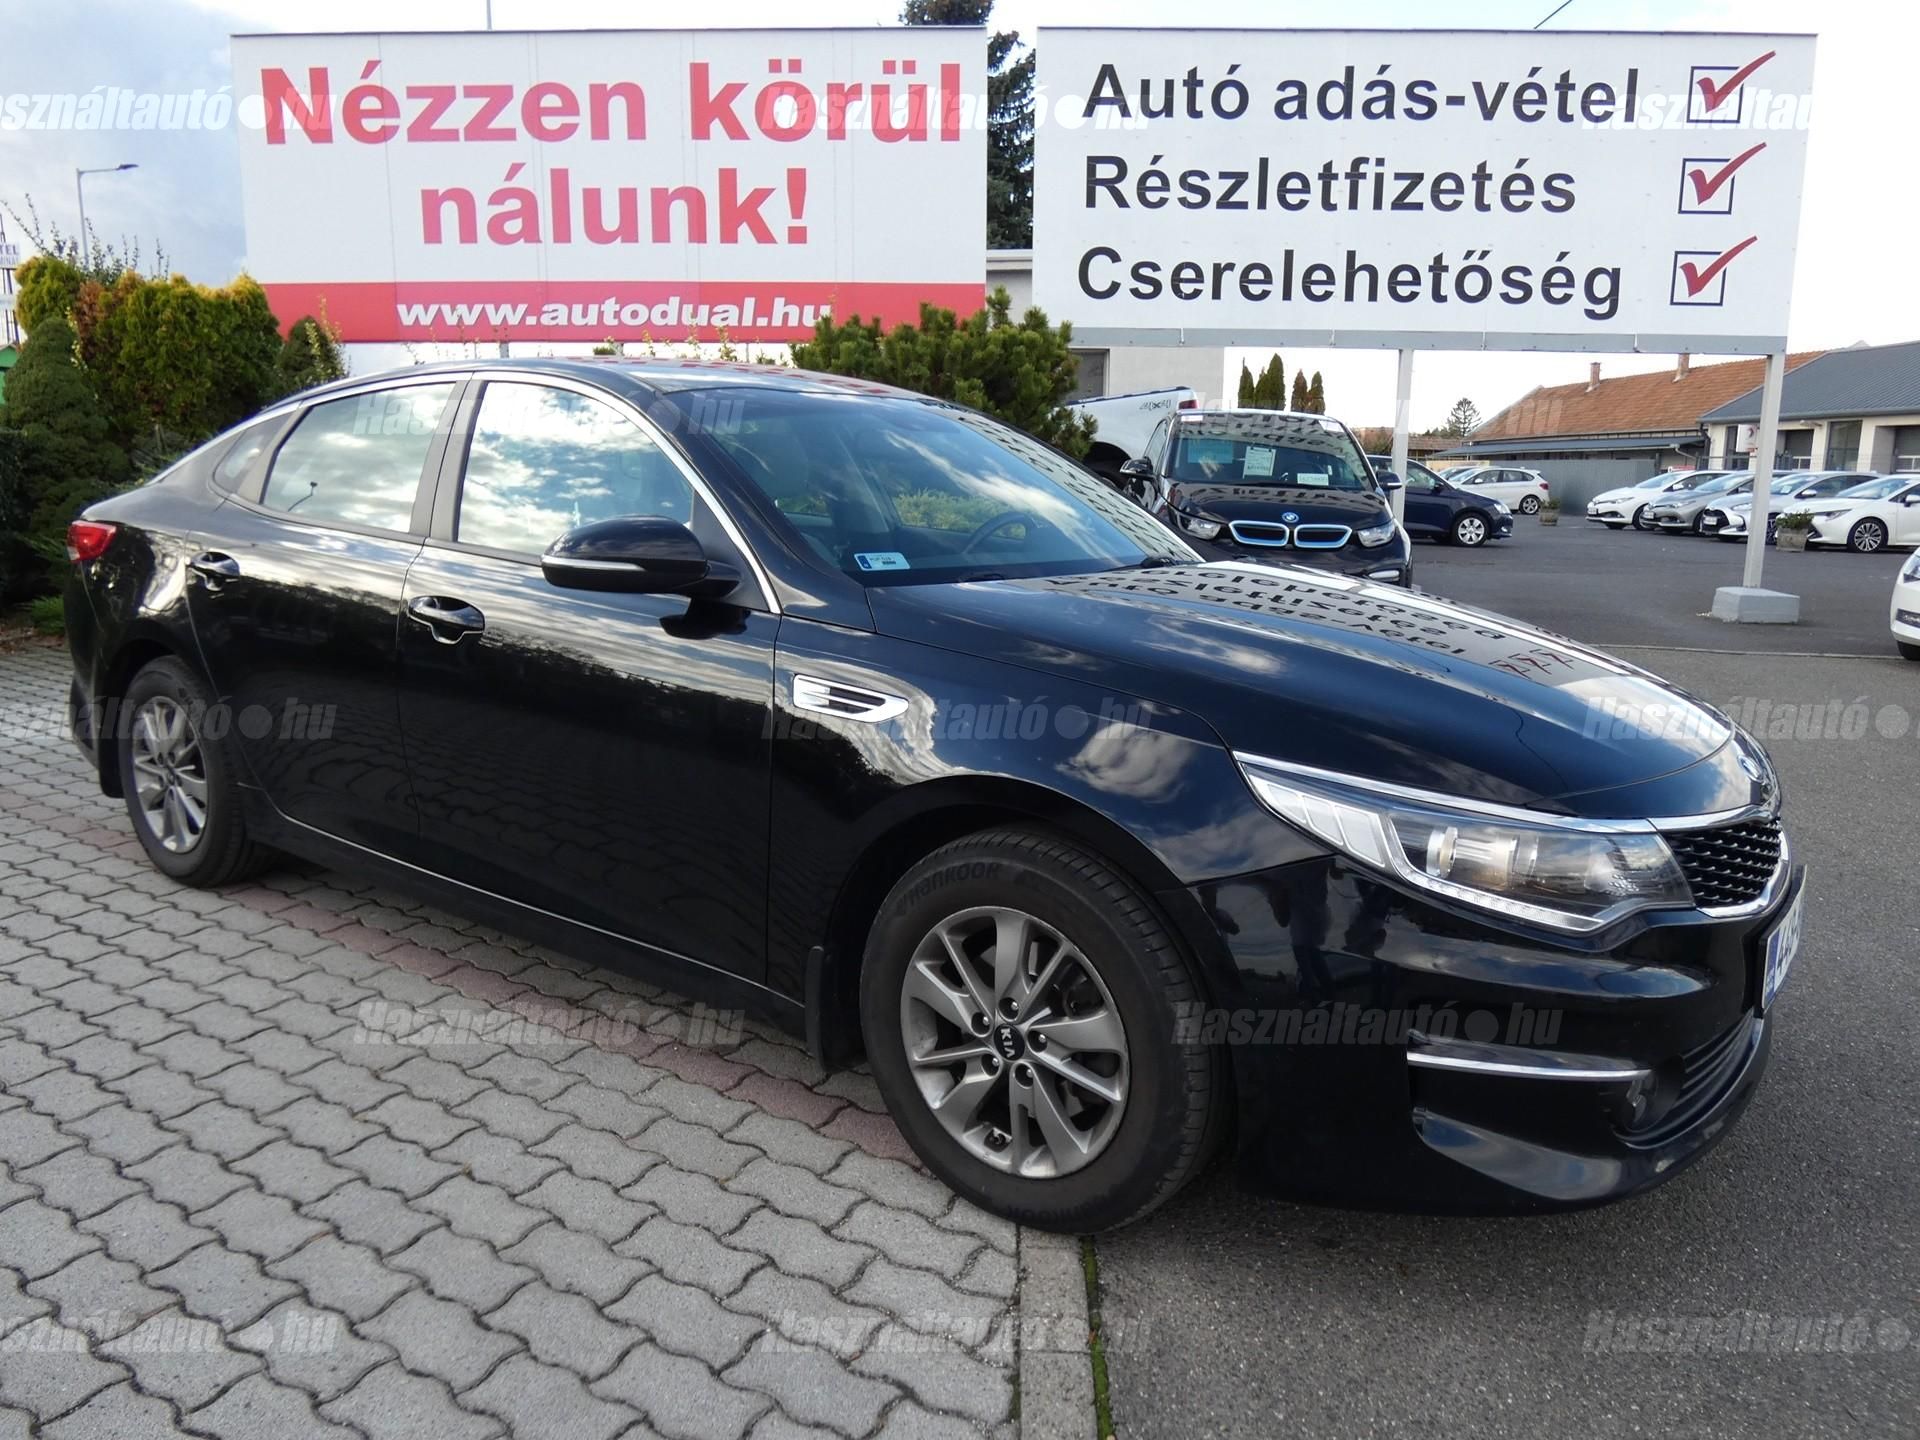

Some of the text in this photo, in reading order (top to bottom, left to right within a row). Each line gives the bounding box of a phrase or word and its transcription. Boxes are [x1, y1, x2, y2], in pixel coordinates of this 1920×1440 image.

[261, 58, 961, 145] Nézzen körül
[1083, 63, 1639, 123] Autó adás-vétel
[421, 162, 808, 245] nálunk!
[1085, 154, 1576, 213] Részletfizetés
[397, 296, 832, 327] www.autodual.hu
[1078, 246, 1622, 320] Cserelehetőség
